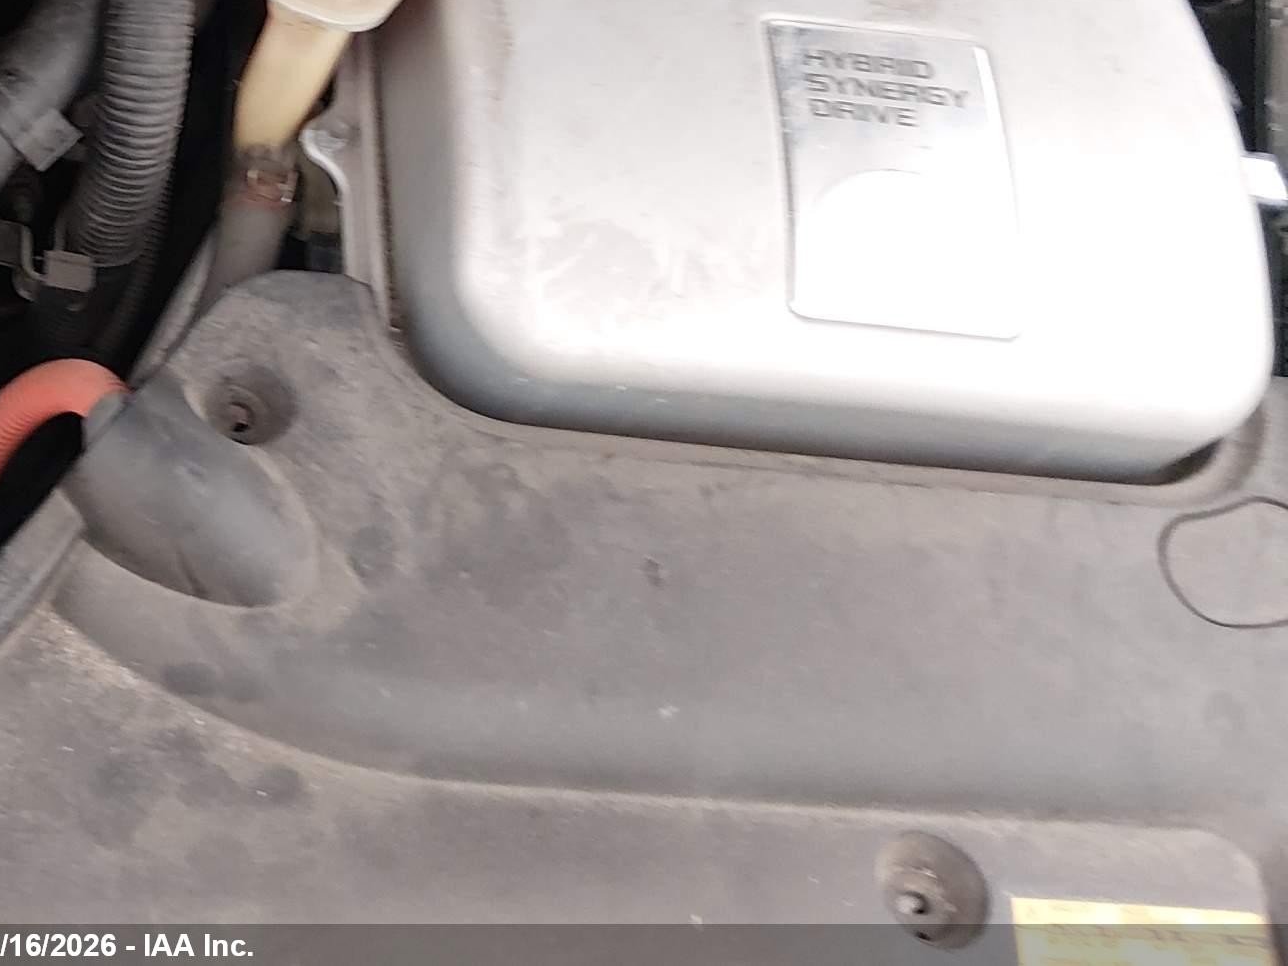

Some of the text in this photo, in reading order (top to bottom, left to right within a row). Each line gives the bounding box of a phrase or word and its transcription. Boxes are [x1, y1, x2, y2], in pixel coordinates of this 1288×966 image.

[804, 49, 935, 79] HYBRID
[805, 73, 969, 109] SYNERGY
[809, 98, 919, 127] DRIVE
